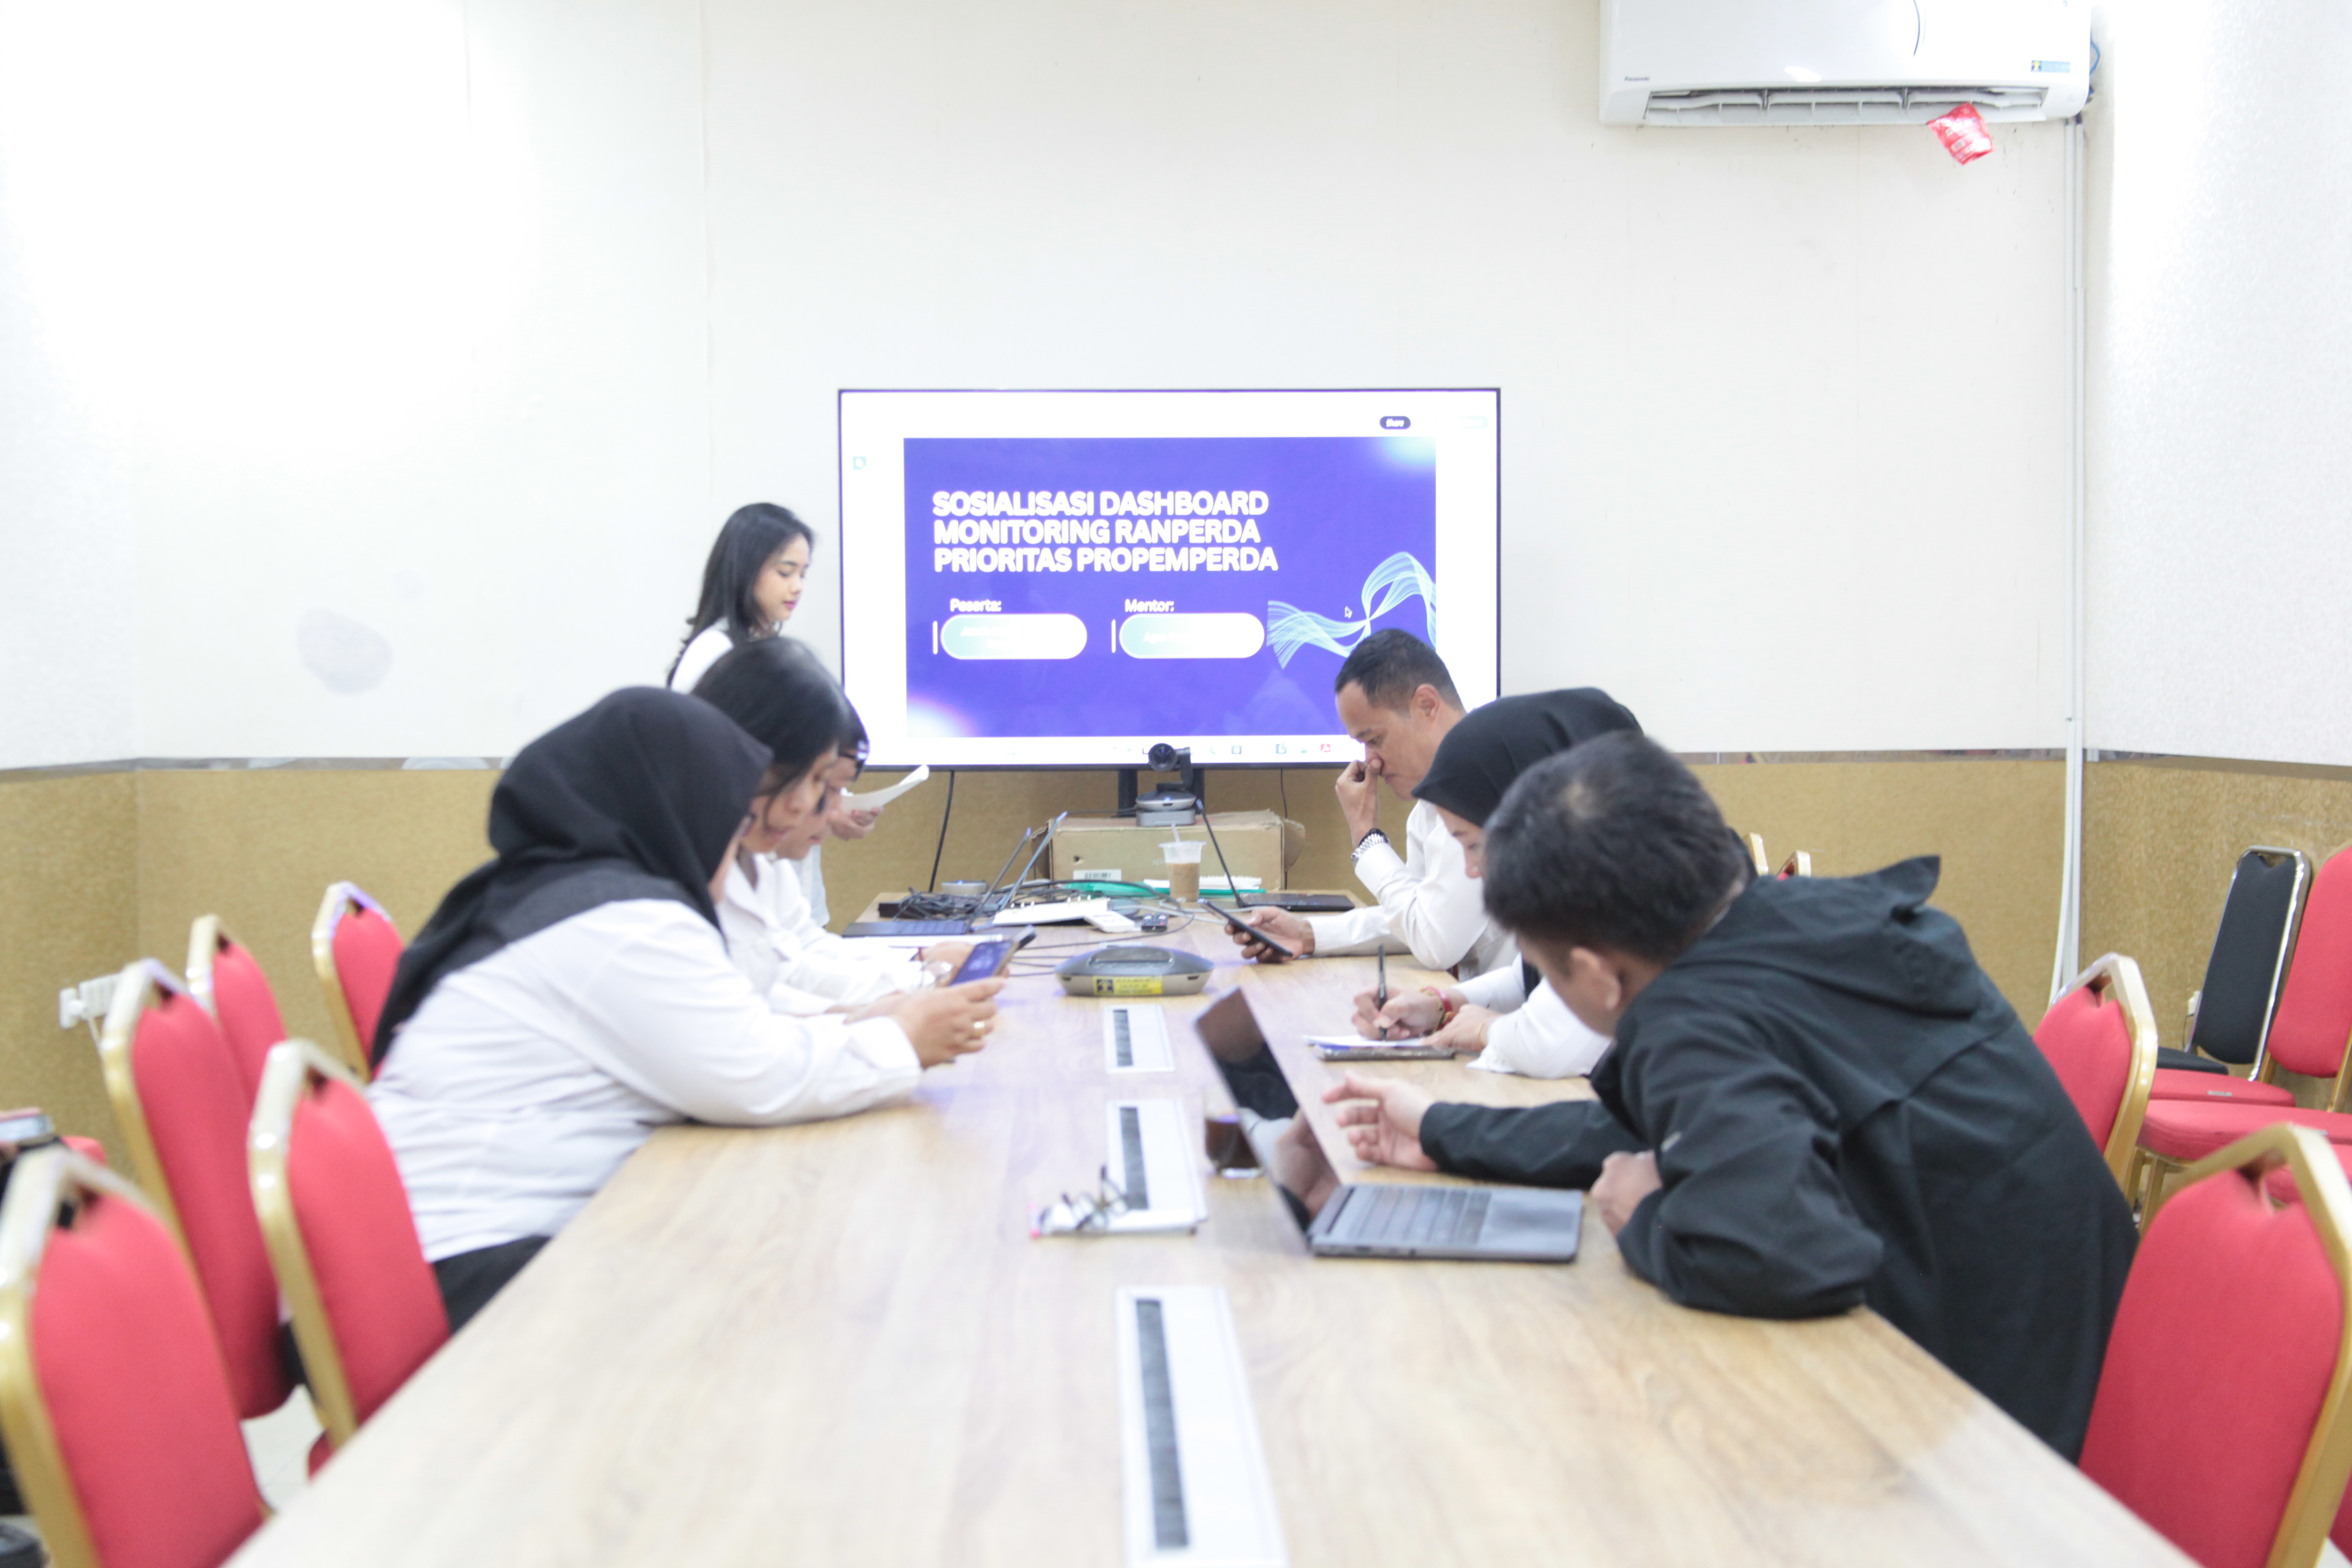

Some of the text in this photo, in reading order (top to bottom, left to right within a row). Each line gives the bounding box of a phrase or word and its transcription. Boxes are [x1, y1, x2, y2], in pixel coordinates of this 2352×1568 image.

[933, 490, 1269, 516] SOSIALISASI DASHBOARD
[934, 519, 1261, 544] MONITORING RANPERDA
[934, 547, 1279, 572] PRIORITAS PROPEMPERDA
[950, 598, 1002, 612] Peserta:
[1124, 598, 1174, 612] Mentor:
